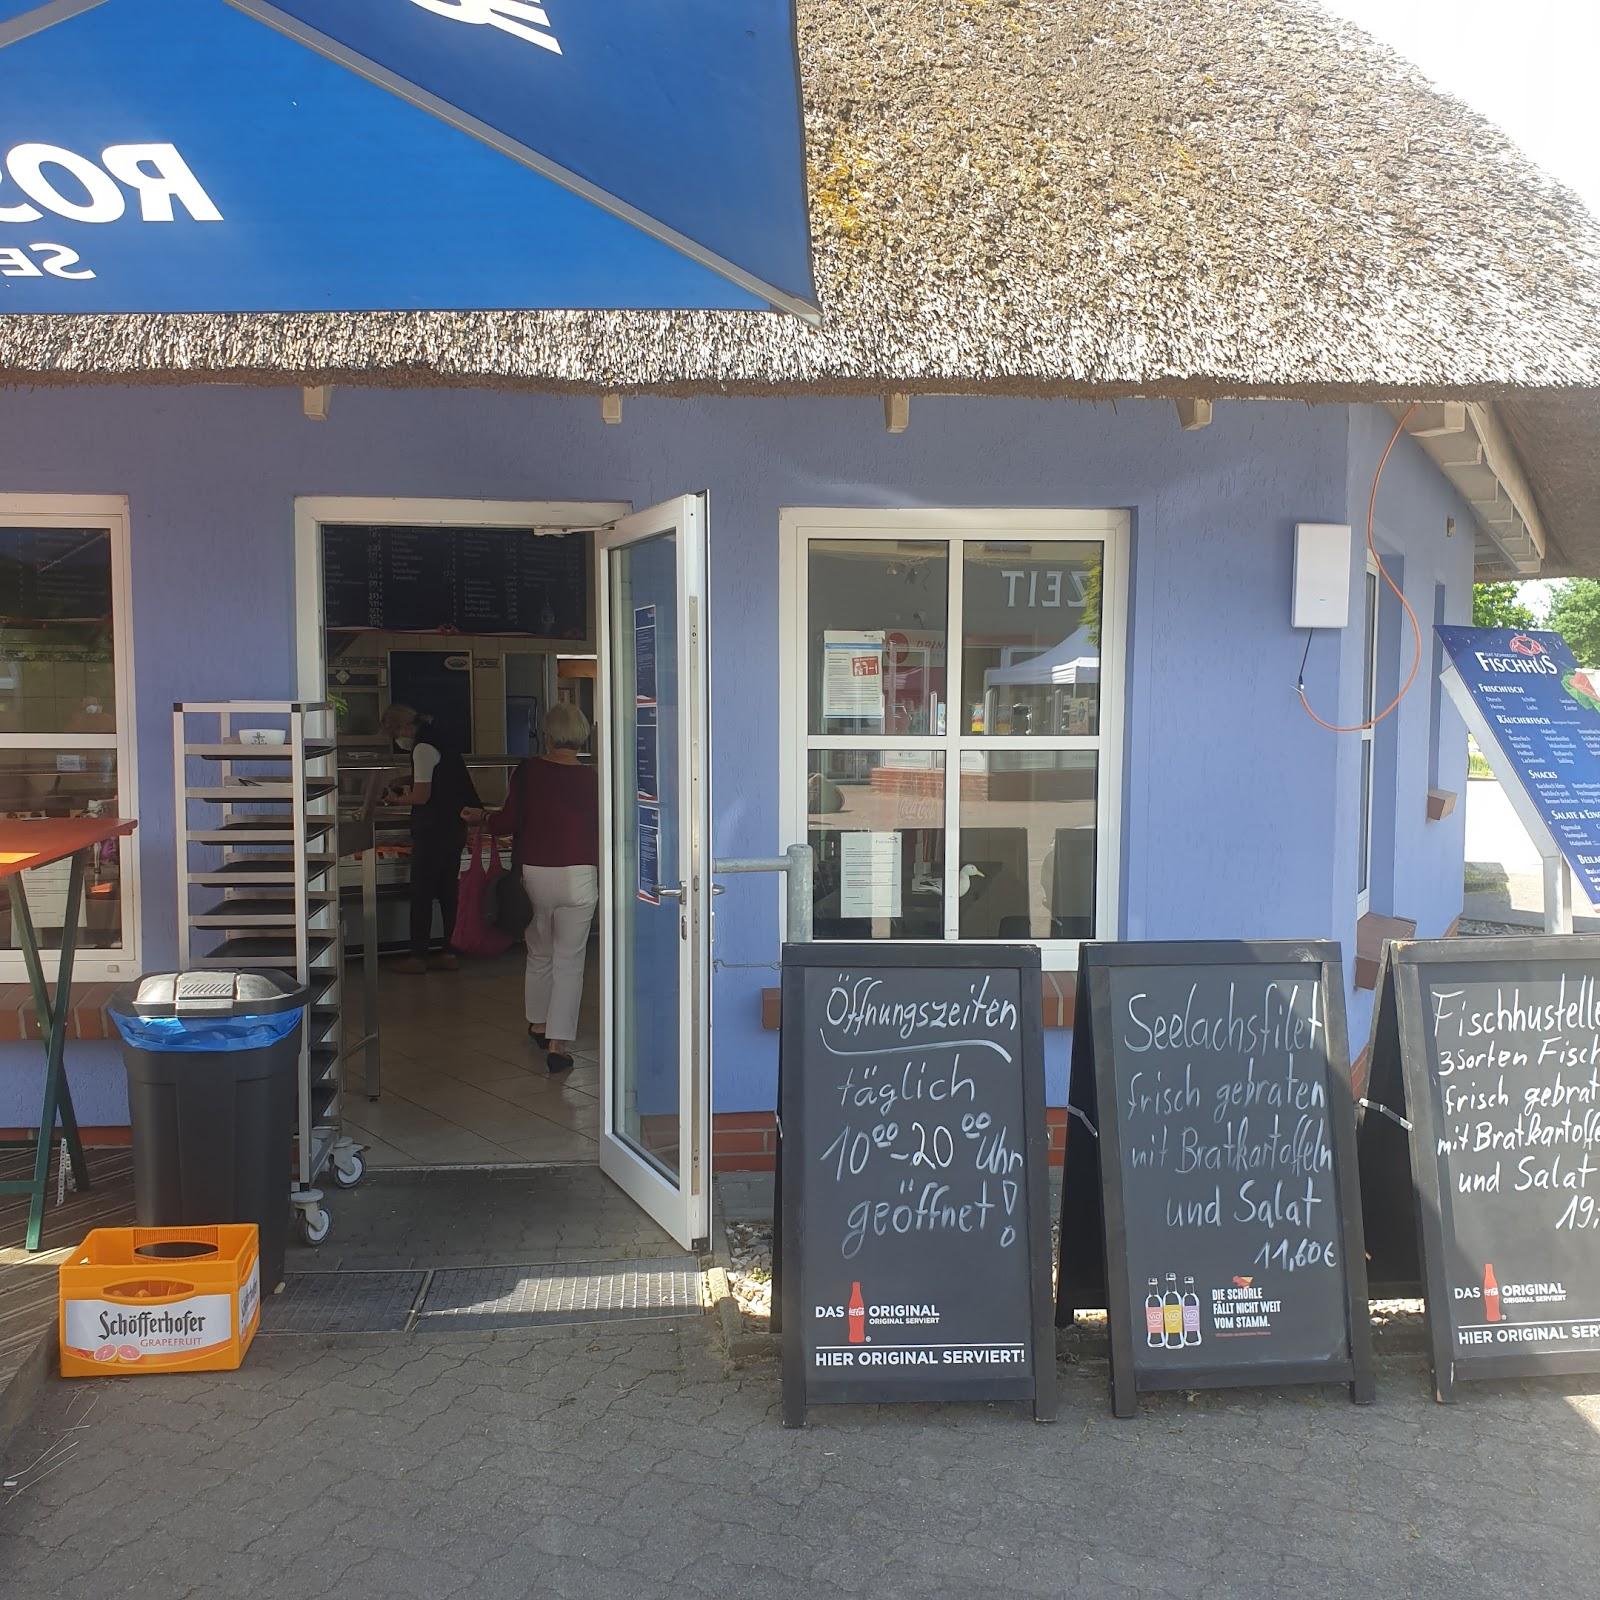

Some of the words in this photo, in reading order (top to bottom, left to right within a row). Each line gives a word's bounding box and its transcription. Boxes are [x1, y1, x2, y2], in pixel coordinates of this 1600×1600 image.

[1528, 769, 1558, 779] SNACKS
[827, 973, 1018, 1039] Öffnungszeiten
[1124, 981, 1323, 1056] Seelachsfilet
[837, 1053, 975, 1116] täglich
[1128, 1063, 1200, 1120] frisch
[1213, 1052, 1325, 1123] gebraten
[1445, 1074, 1509, 1116] frisch
[975, 1125, 1024, 1175] Uhr
[1132, 1125, 1168, 1169] mit
[1175, 1114, 1333, 1177] Bratkartoffeln
[1437, 1123, 1469, 1156] mit
[1458, 1160, 1500, 1193] und
[1514, 1152, 1598, 1192] Salat
[1166, 1184, 1222, 1228] und
[1233, 1176, 1322, 1229] Salat
[1254, 1238, 1337, 1273] 11,60€
[1212, 1288, 1226, 1300] DIE
[1454, 1287, 1481, 1299] DAS
[1502, 1282, 1567, 1297] ORIGINAL
[815, 1306, 845, 1318] DAS
[868, 1304, 940, 1317] ORIGINAL
[869, 1317, 905, 1325] ORIGINAL
[905, 1317, 940, 1325] SERVIERT
[1213, 1301, 1235, 1315] FÄLLT
[1235, 1302, 1259, 1314] NICHT
[1260, 1301, 1281, 1313] WEIT
[1214, 1317, 1234, 1329] VOM
[1236, 1315, 1271, 1328] STAMM.
[98, 1310, 207, 1341] Schöfferhofer
[1458, 1330, 1493, 1345] HIER
[1496, 1326, 1569, 1343] ORIGINAL
[1571, 1324, 1600, 1338] SER
[140, 1337, 202, 1347] GRAPEFRUIT
[815, 1352, 854, 1367] HIER
[858, 1350, 939, 1366] ORIGINAL
[942, 1349, 1025, 1364] SERVIERT!
